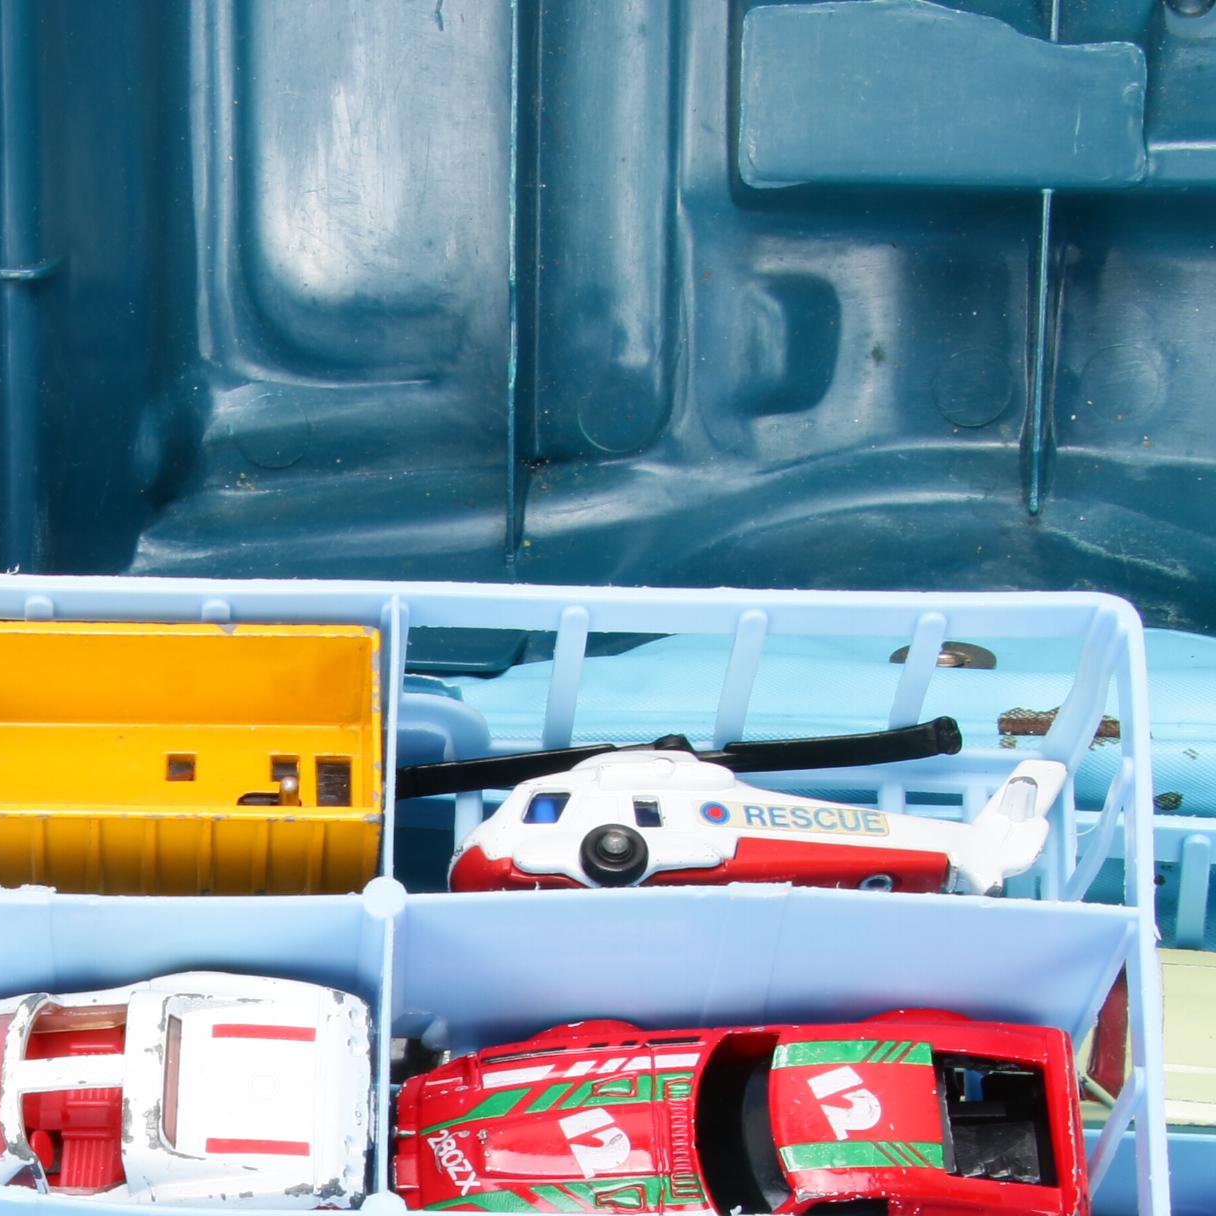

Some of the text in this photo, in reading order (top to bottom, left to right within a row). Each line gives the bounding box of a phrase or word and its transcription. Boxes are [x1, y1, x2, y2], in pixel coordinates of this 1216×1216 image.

[743, 804, 887, 834] RESCUE
[806, 1065, 883, 1141] 12
[426, 1129, 482, 1197] 280ZX
[557, 1106, 631, 1180] 12
